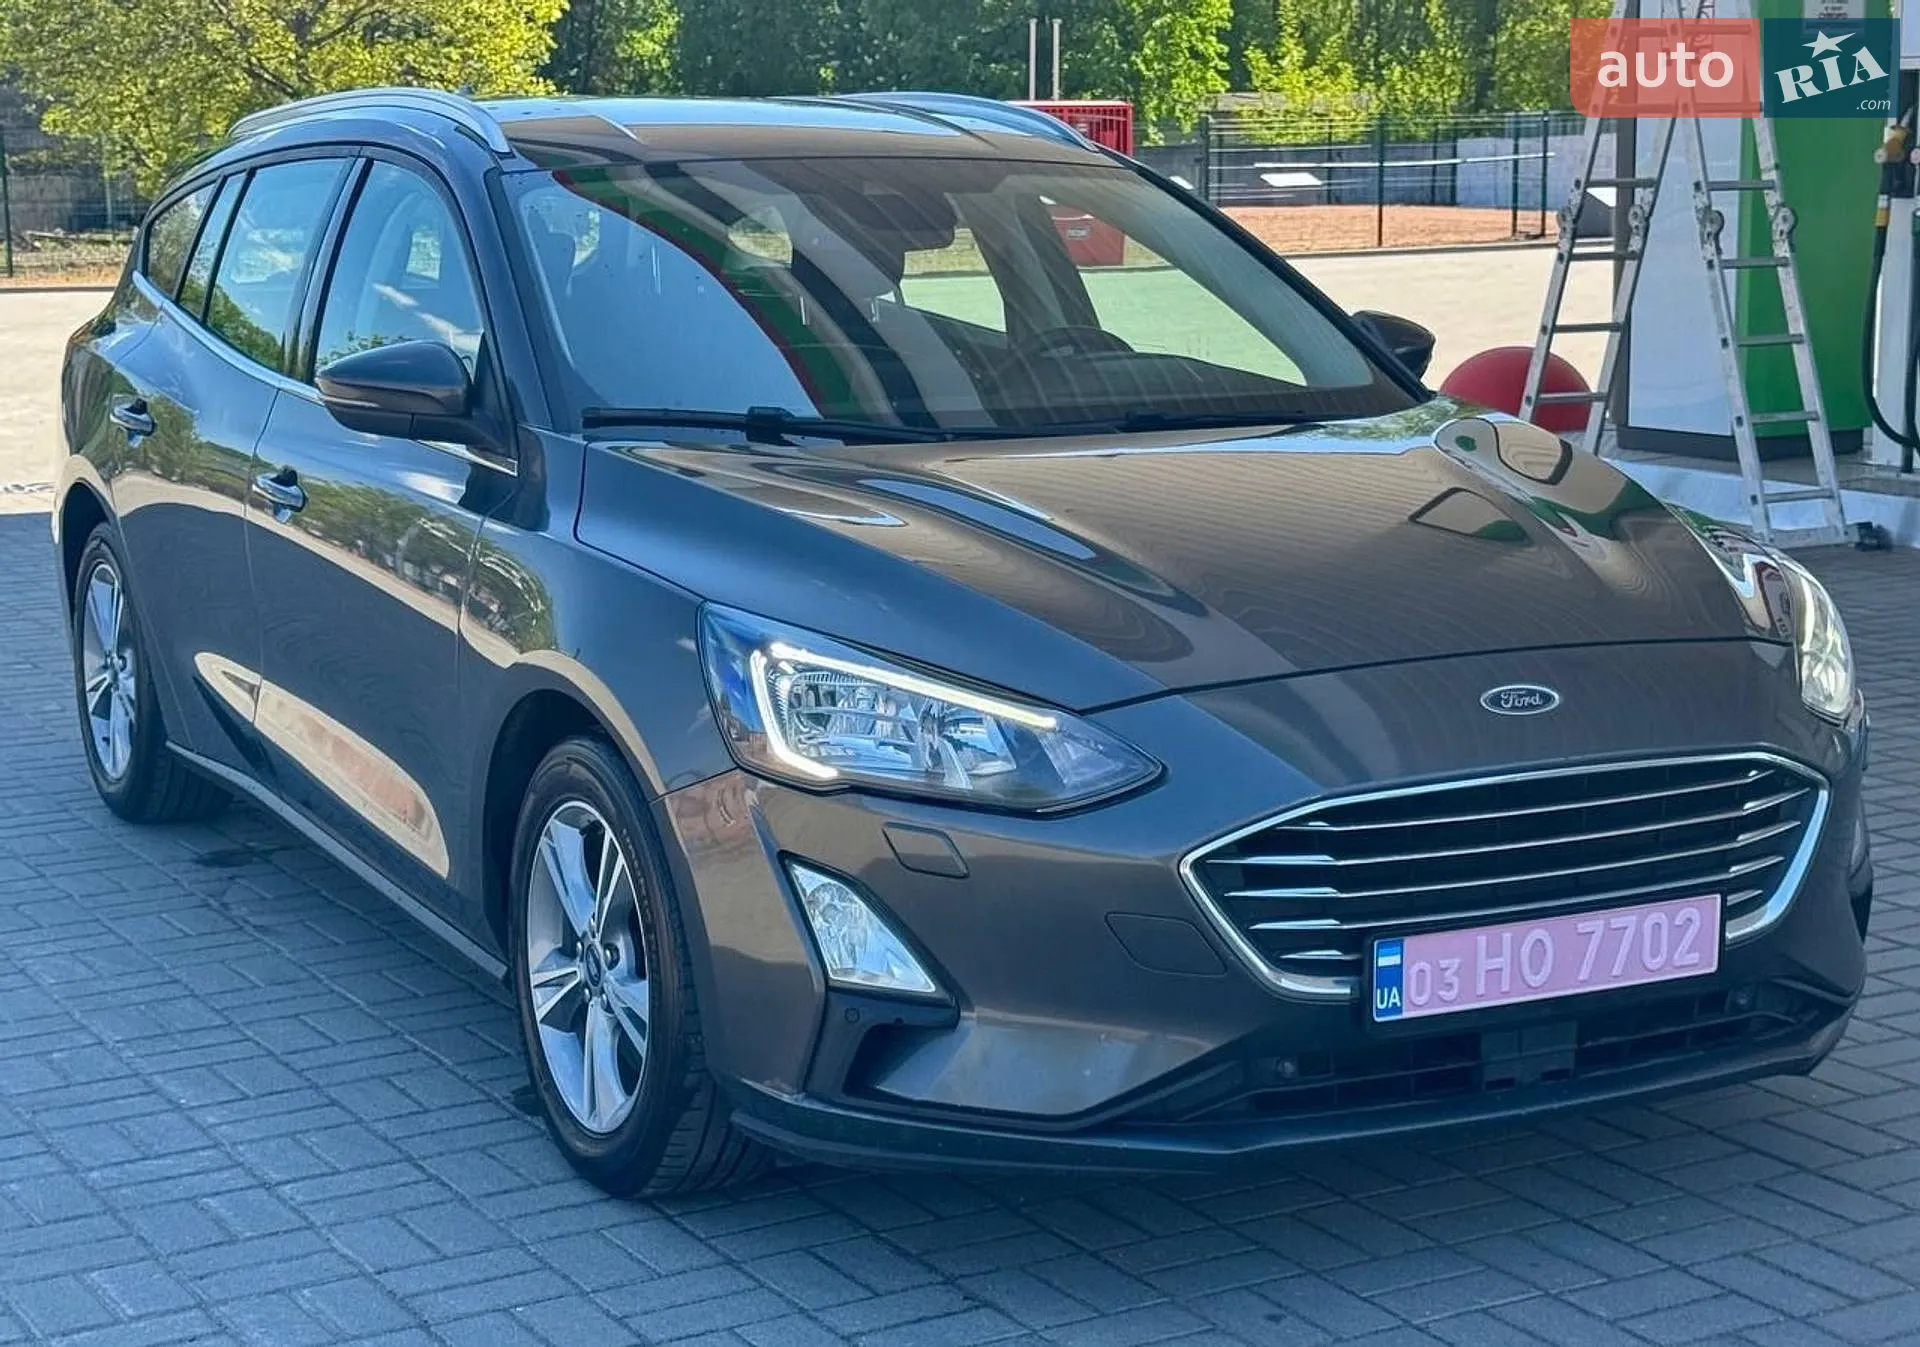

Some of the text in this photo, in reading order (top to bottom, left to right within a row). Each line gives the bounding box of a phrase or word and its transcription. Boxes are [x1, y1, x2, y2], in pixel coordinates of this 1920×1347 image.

[1501, 690, 1543, 708] Ford
[1409, 958, 1461, 1006] 03
[1576, 907, 1701, 982] 7702
[1376, 986, 1401, 1009] UA
